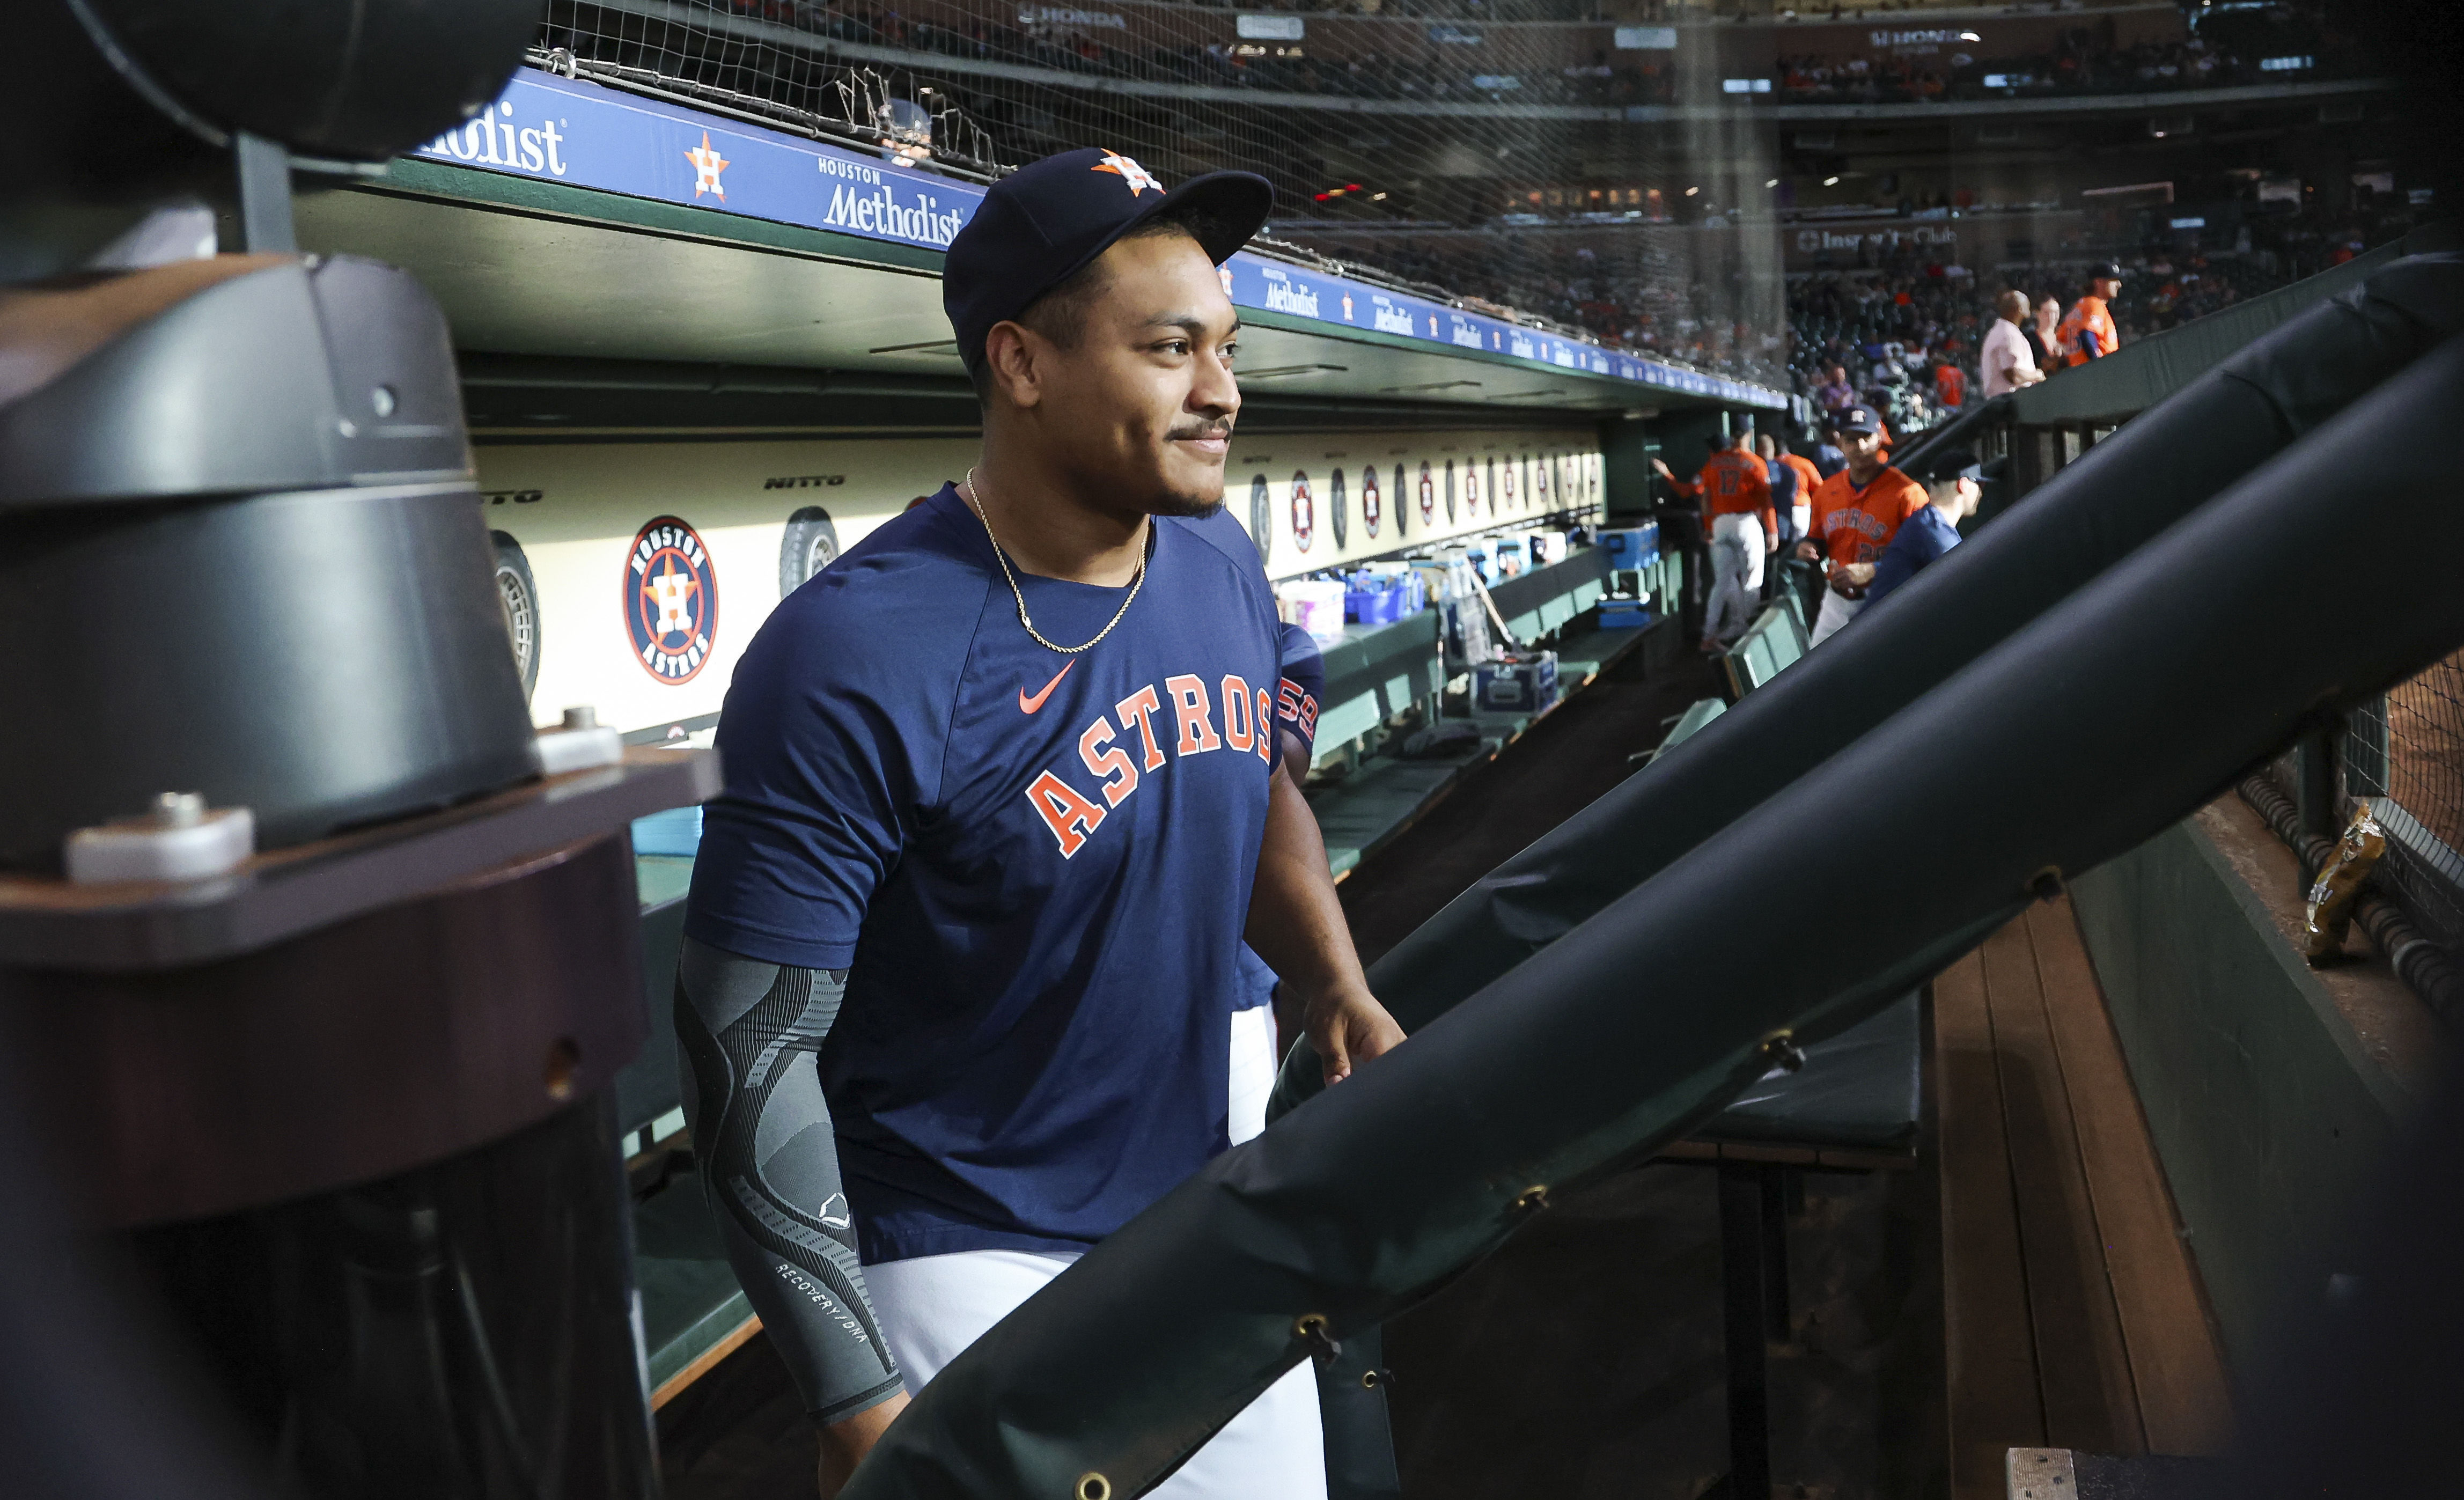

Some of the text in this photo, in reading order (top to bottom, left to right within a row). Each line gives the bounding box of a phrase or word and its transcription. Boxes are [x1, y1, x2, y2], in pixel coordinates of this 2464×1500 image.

[818, 157, 881, 185] HOUSTON
[822, 183, 962, 246] Methodist
[764, 475, 845, 489] NITTO
[631, 526, 705, 576] HOUSTON
[643, 633, 709, 678] ASTROS
[1278, 677, 1318, 742] 59
[1025, 673, 1271, 860] ASTROS
[776, 1263, 868, 1343] RECOVERY/DNA
